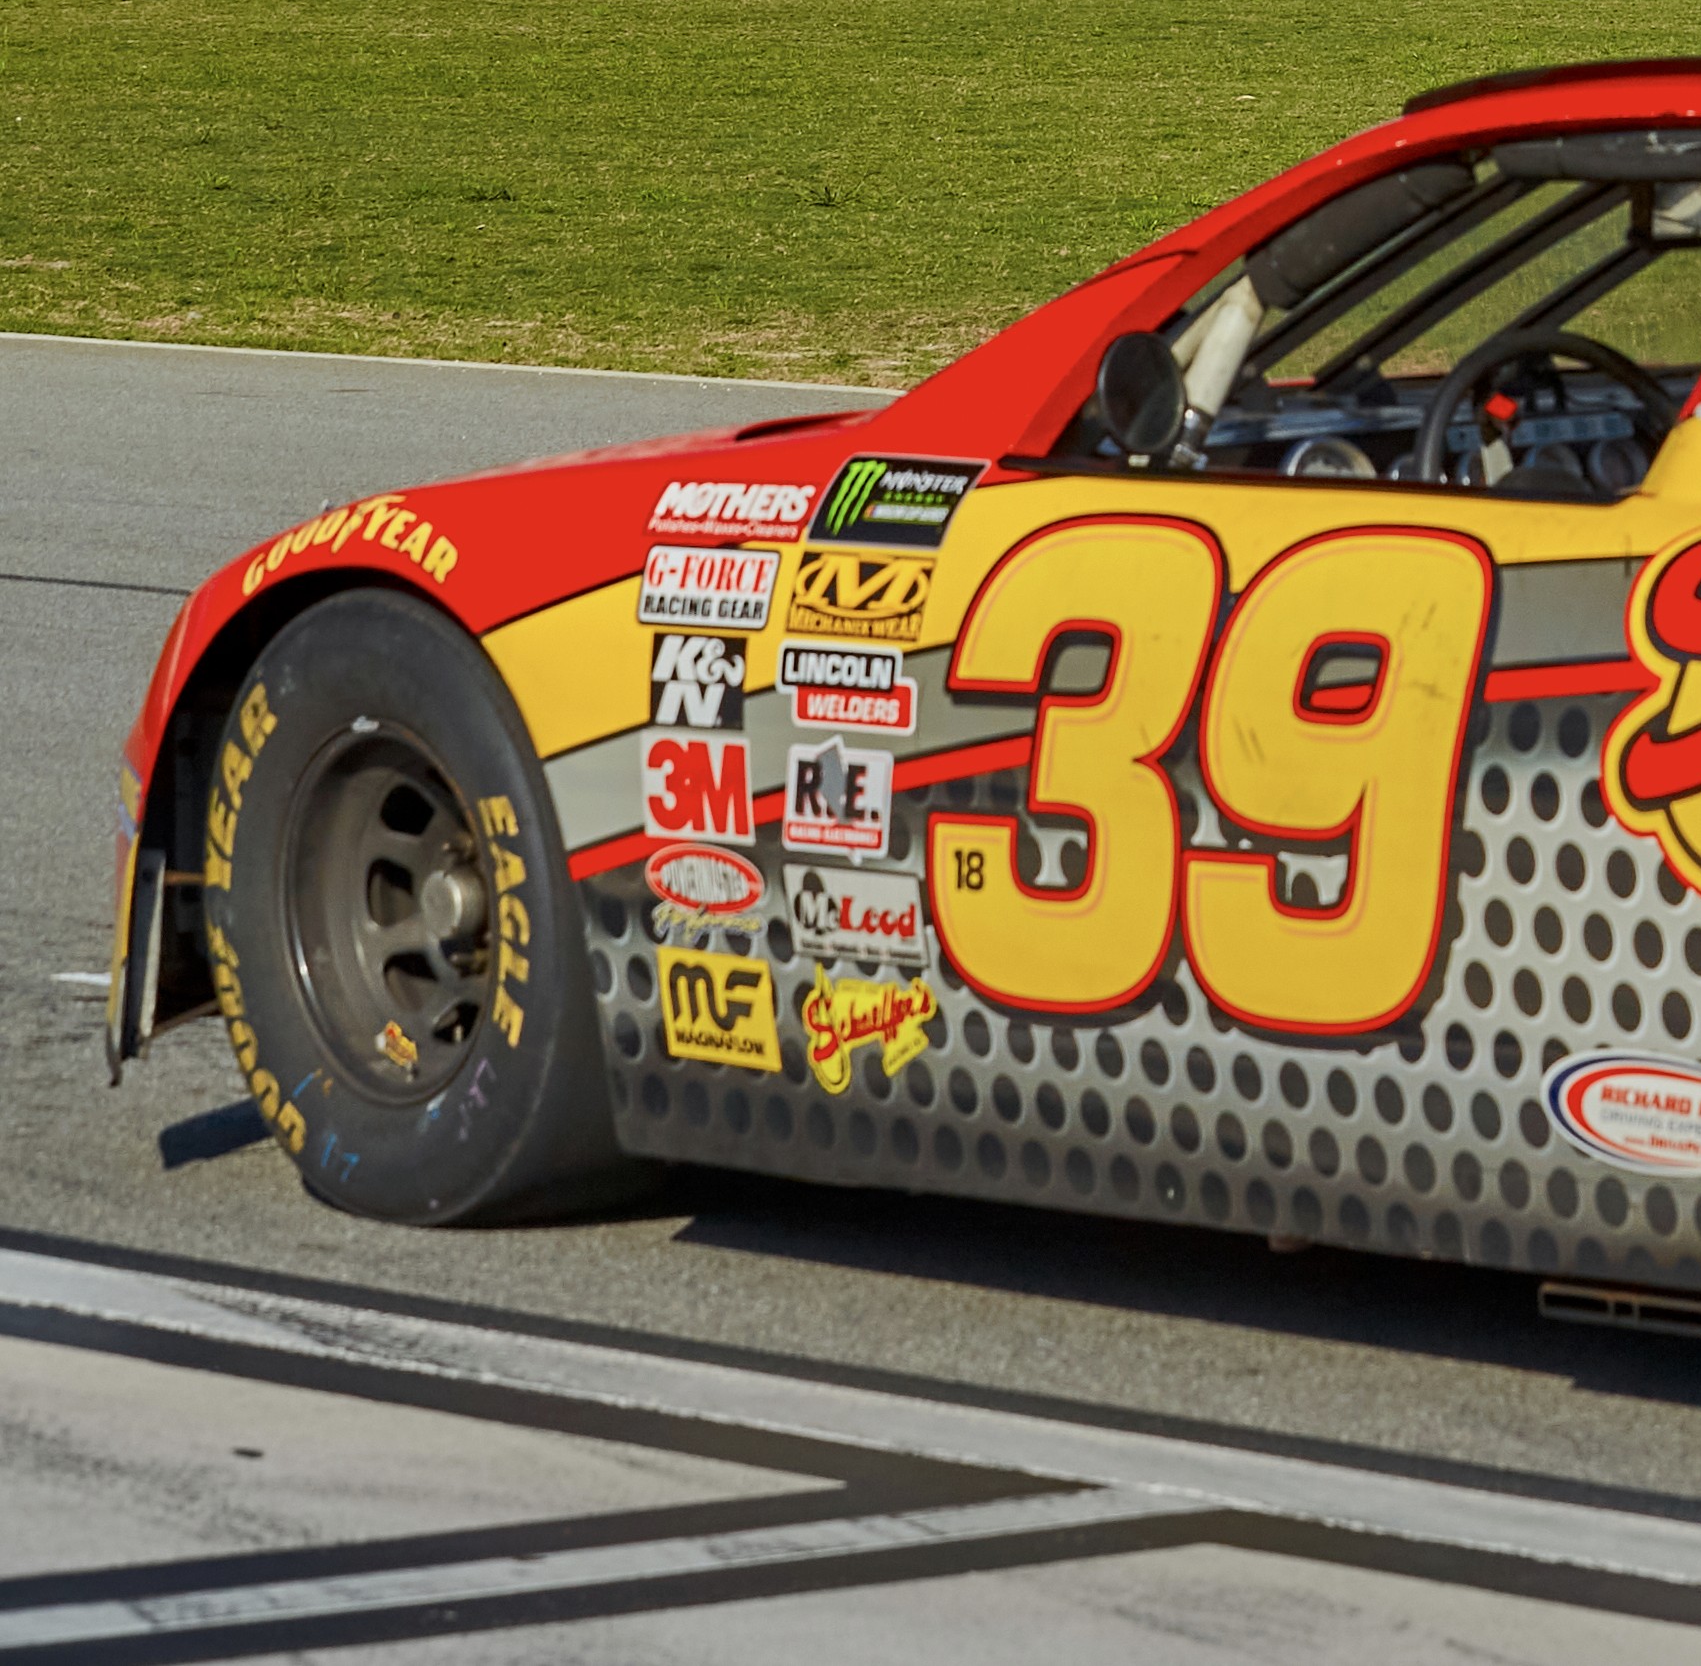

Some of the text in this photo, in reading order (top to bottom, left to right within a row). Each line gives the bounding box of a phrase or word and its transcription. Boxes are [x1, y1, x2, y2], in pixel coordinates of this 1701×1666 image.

[654, 481, 816, 523] MOTHERS
[879, 469, 968, 495] MONSTER
[242, 494, 459, 597] GOODYEAR
[648, 552, 774, 594] G-FORCE
[643, 595, 765, 621] RACING GEAR
[785, 650, 894, 691] LINCOLN
[806, 692, 900, 724] WELDERS
[647, 738, 749, 835] 3M
[926, 513, 1494, 1034] 39
[955, 851, 985, 891] 18
[478, 795, 531, 1049] EAGLE
[1600, 1085, 1693, 1116] RICHARD
